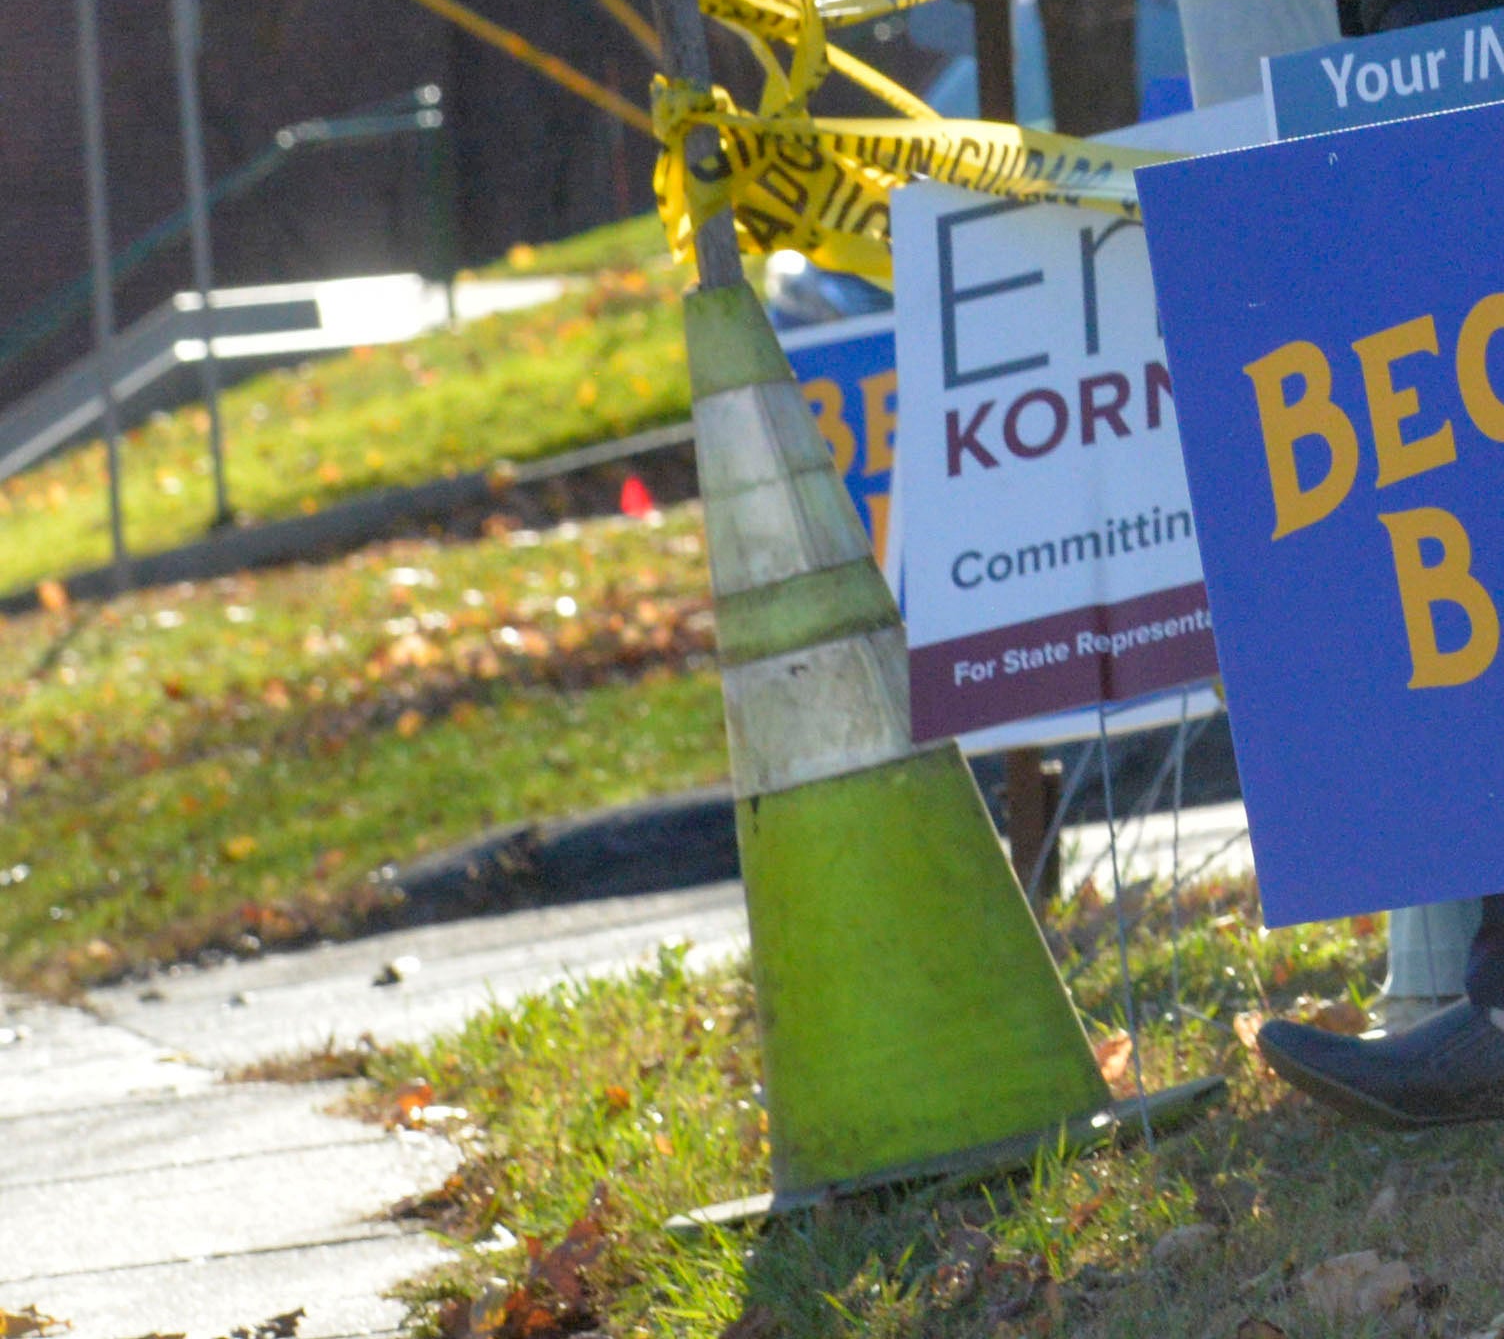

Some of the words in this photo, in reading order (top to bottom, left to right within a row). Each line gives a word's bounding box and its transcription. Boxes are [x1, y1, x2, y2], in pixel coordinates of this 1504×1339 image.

[1320, 48, 1446, 108] Your
[951, 505, 1192, 590] Committin
[953, 658, 997, 688] For
[1003, 642, 1070, 674] State
